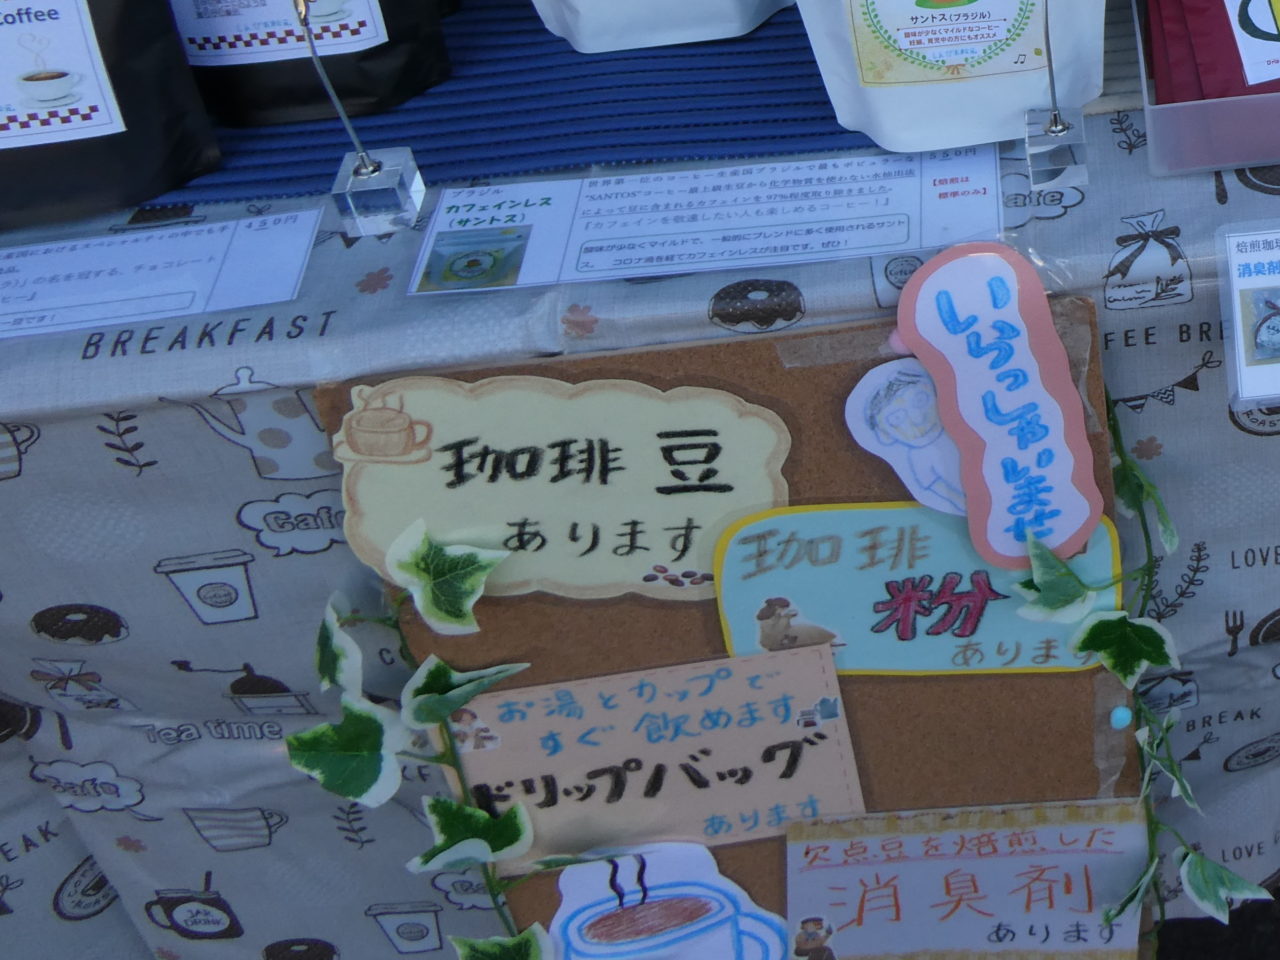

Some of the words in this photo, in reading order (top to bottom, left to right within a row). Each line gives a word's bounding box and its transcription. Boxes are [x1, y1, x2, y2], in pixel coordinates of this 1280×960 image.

[444, 196, 553, 214] カフェインレス
[81, 310, 338, 361] BREAKFAST
[935, 276, 1062, 542] いらっしゃいませ
[435, 429, 734, 495] 珈琲豆
[502, 517, 702, 562] あります
[737, 528, 932, 581] 珈琲
[872, 569, 1009, 642] 粉
[496, 666, 780, 724] お湯とカップで
[1186, 707, 1262, 733] BREAK
[204, 718, 283, 740] time
[540, 693, 795, 757] すぐ飲めます
[472, 731, 828, 819] ドリップバッグ
[703, 794, 821, 836] あります
[803, 828, 1115, 866] 欠点豆を焙煎した
[1221, 841, 1265, 863] LOVE
[829, 864, 1093, 932] 消臭剤
[987, 921, 1123, 945] あります
